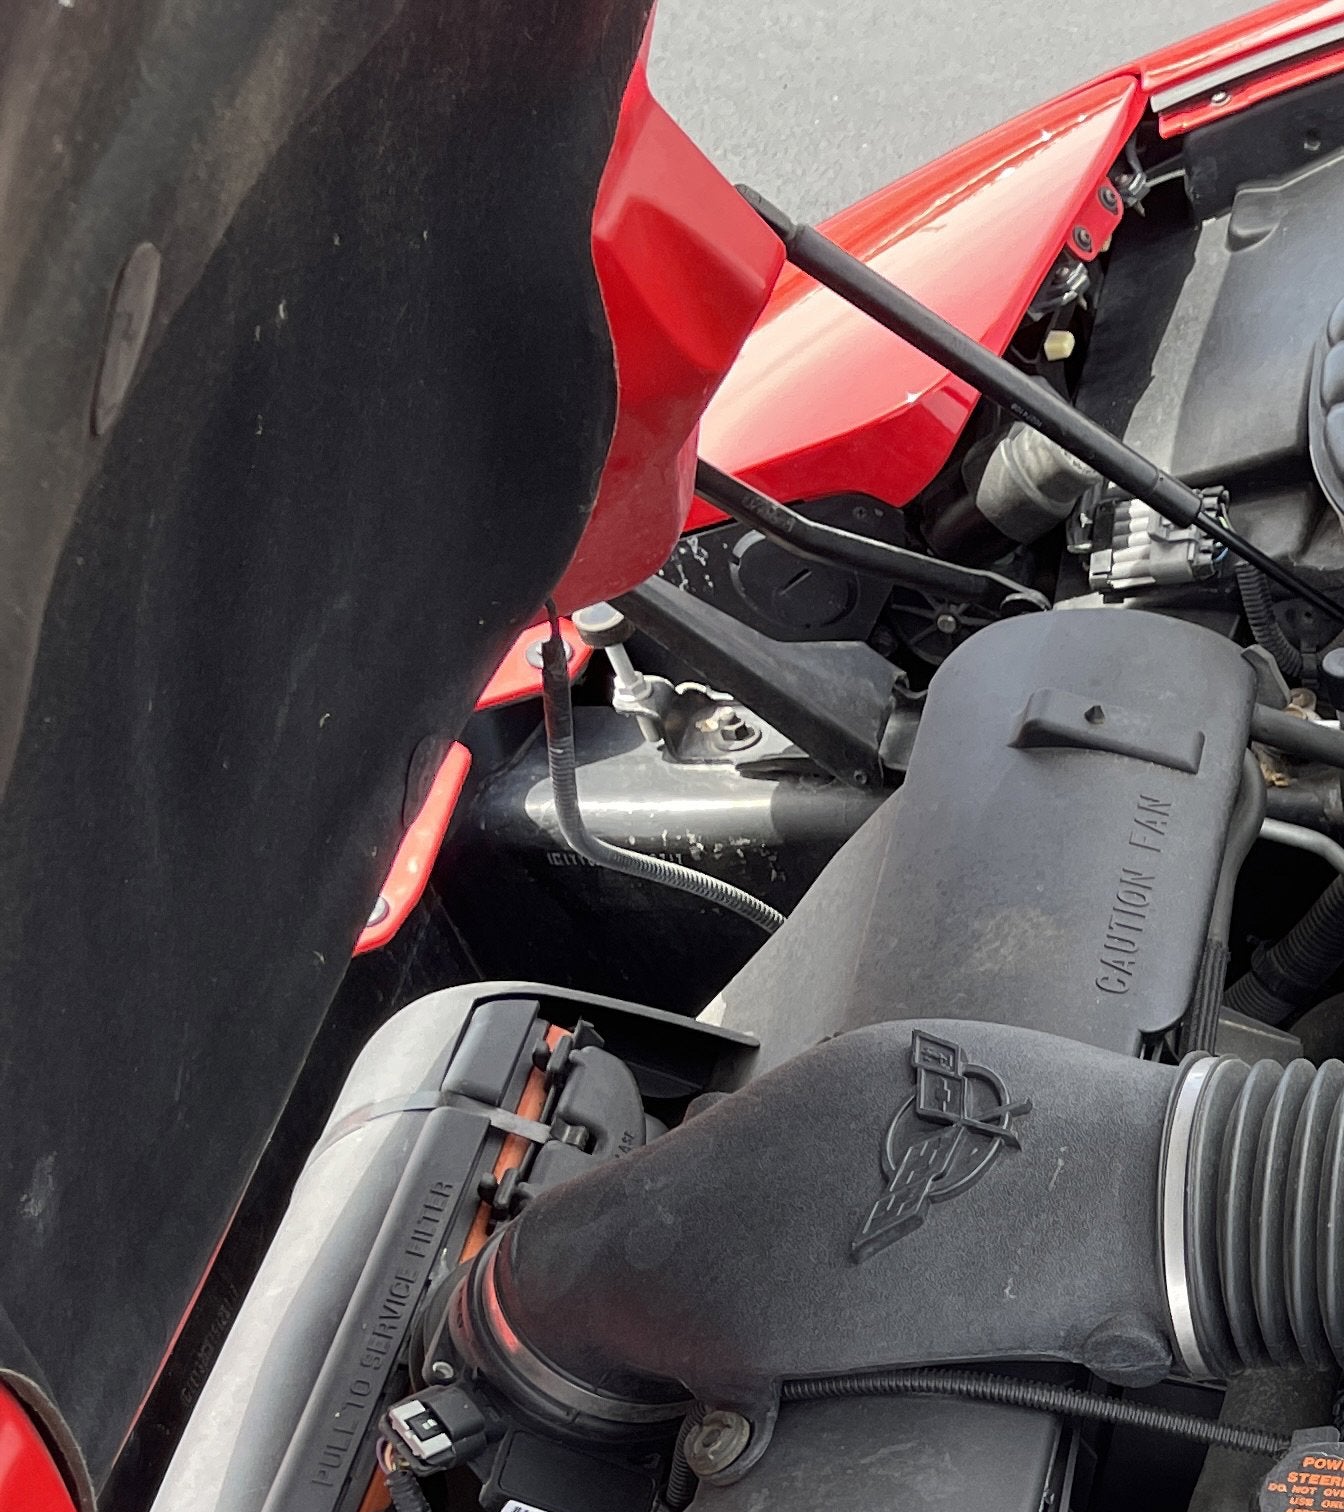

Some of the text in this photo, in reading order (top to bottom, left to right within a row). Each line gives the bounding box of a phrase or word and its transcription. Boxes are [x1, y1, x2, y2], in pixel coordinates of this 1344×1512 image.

[1095, 794, 1172, 995] CAUTION FAN
[311, 1419, 360, 1489] PULL
[360, 1274, 417, 1372] SERVICE
[405, 1180, 453, 1259] FILTER
[1267, 1482, 1288, 1493] DO
[1291, 1485, 1318, 1495] NOT
[1289, 1497, 1315, 1507] USE
